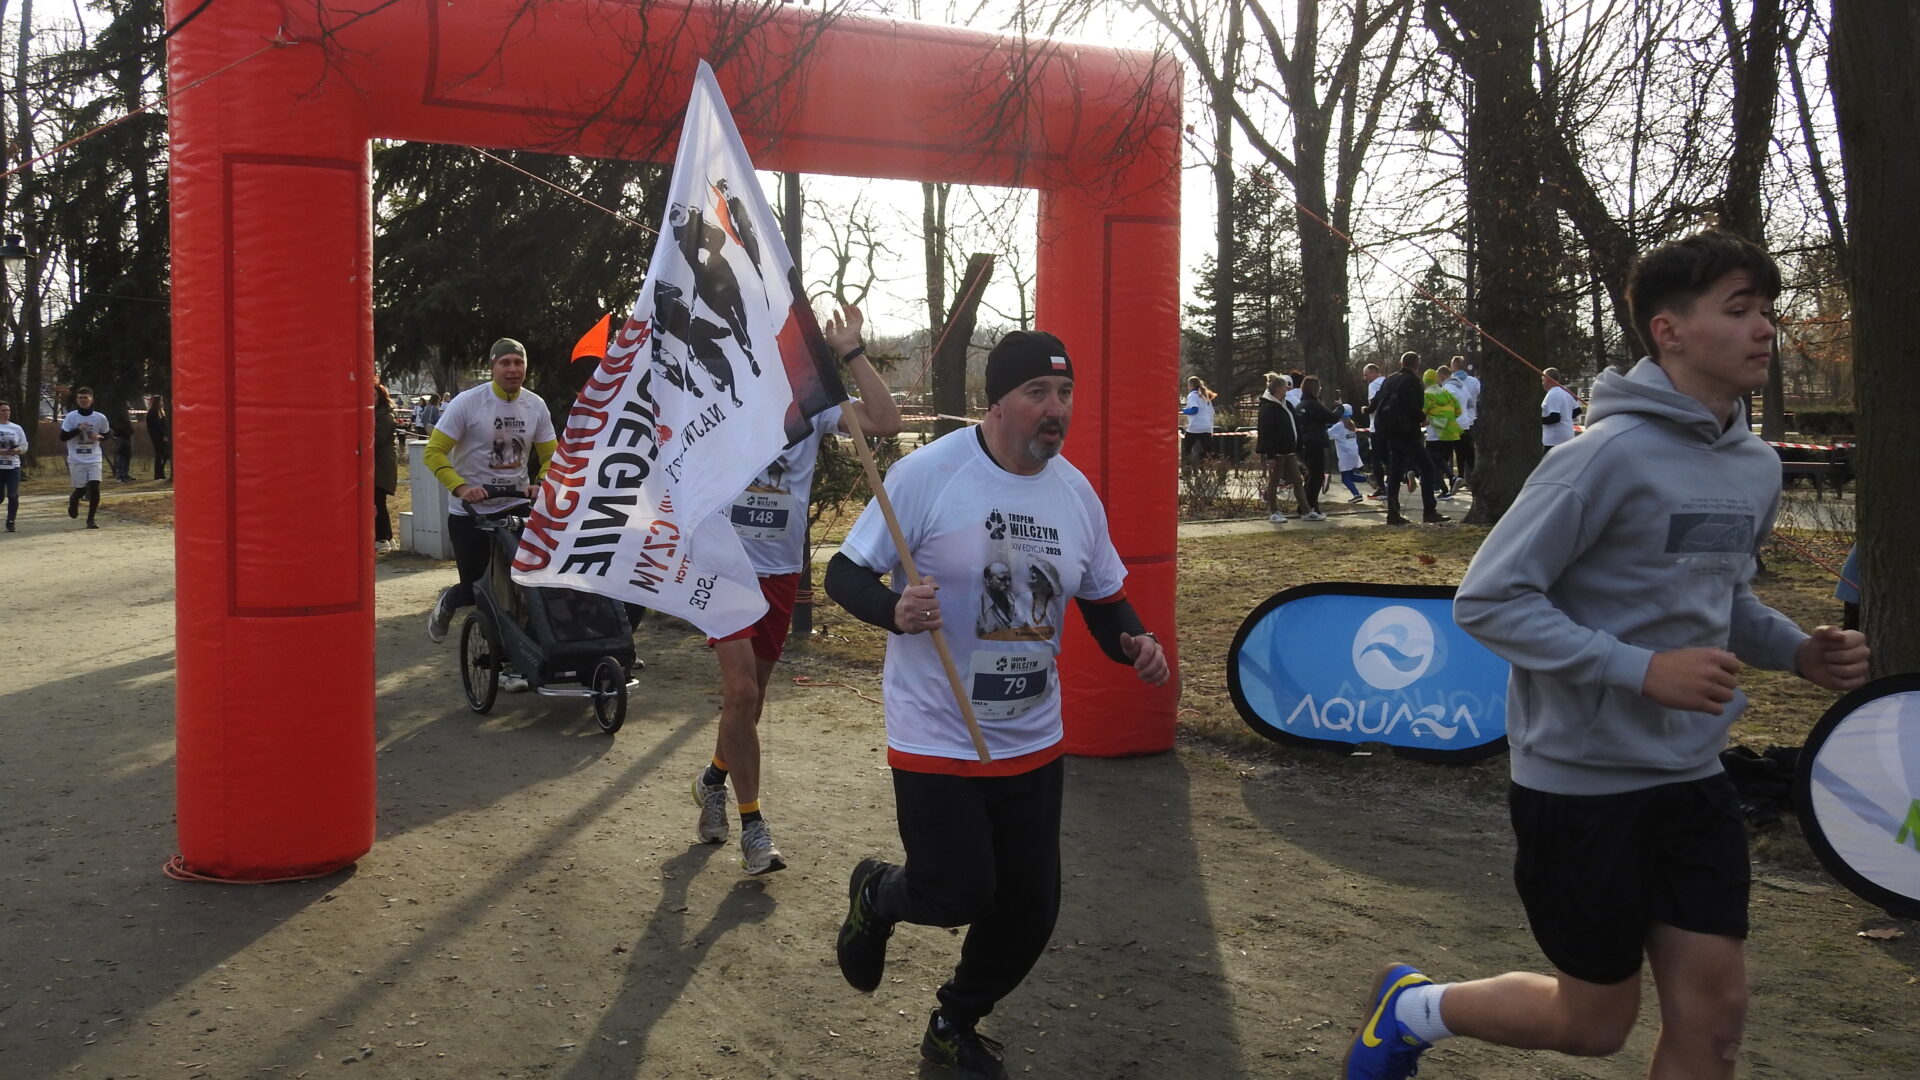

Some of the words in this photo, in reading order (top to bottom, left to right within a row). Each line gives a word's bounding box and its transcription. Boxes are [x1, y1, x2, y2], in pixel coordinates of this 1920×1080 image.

[748, 510, 774, 524] 148
[1008, 513, 1035, 524] TROPEM
[1009, 523, 1059, 541] WILCZYM
[1011, 543, 1022, 551] XIV
[1022, 544, 1045, 554] EDYCJA
[1010, 660, 1039, 670] WILCZYM
[1003, 676, 1027, 695] 79
